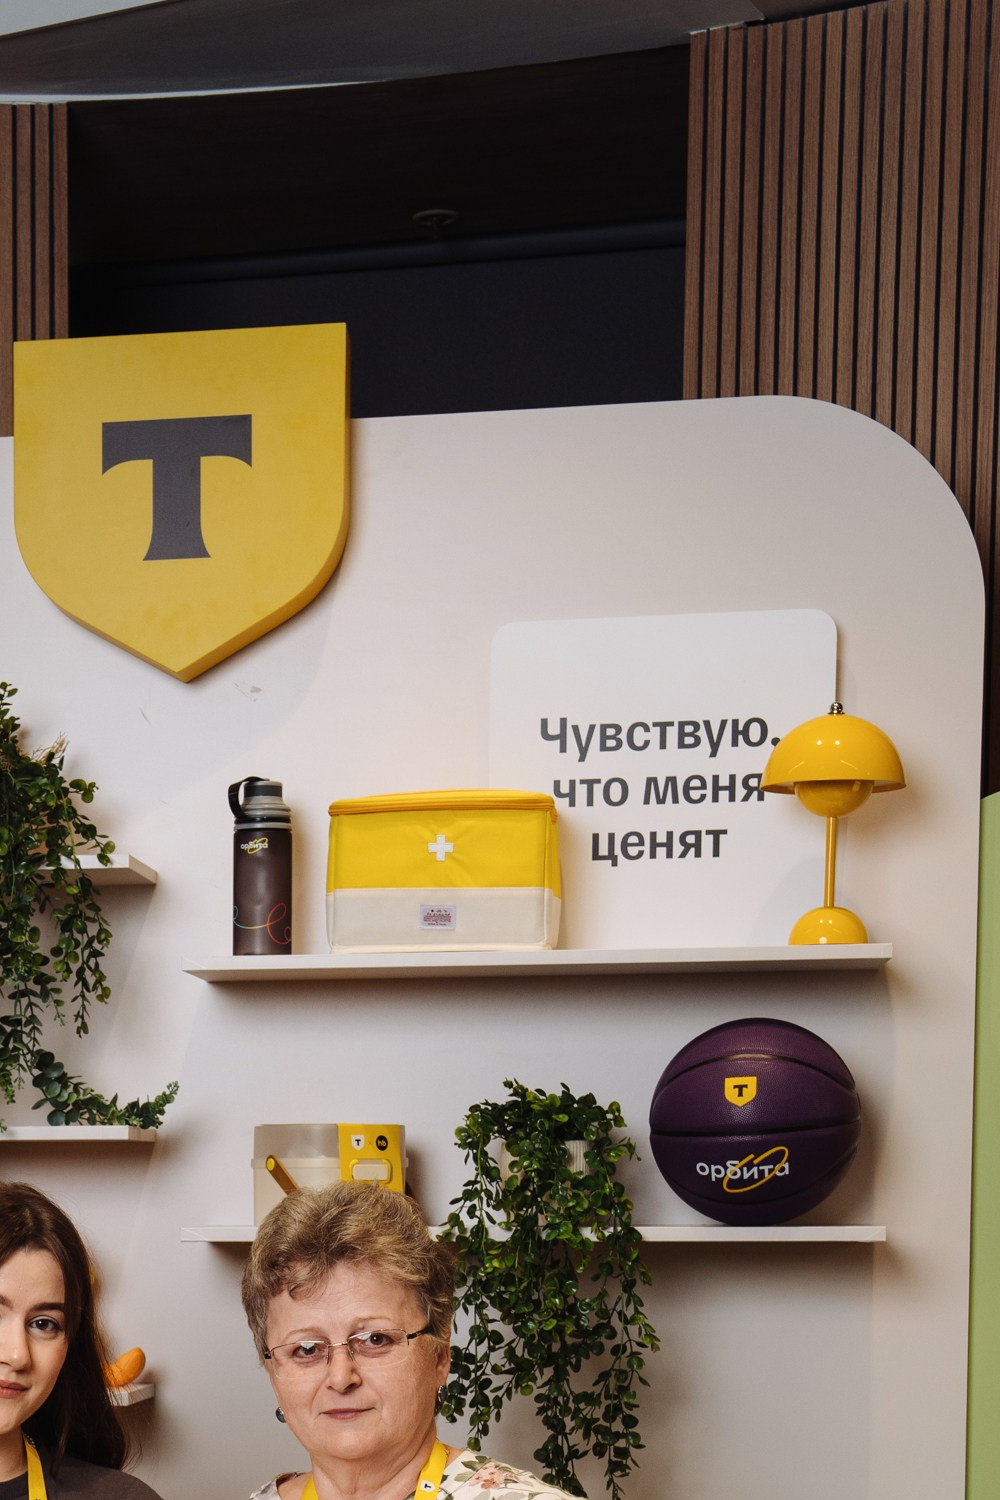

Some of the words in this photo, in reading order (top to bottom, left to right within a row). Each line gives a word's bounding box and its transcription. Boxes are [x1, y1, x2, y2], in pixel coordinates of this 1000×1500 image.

[102, 413, 252, 561] Т
[553, 776, 629, 808] что
[643, 773, 765, 806] меня
[591, 829, 728, 867] ценят
[696, 1159, 790, 1181] орбита
